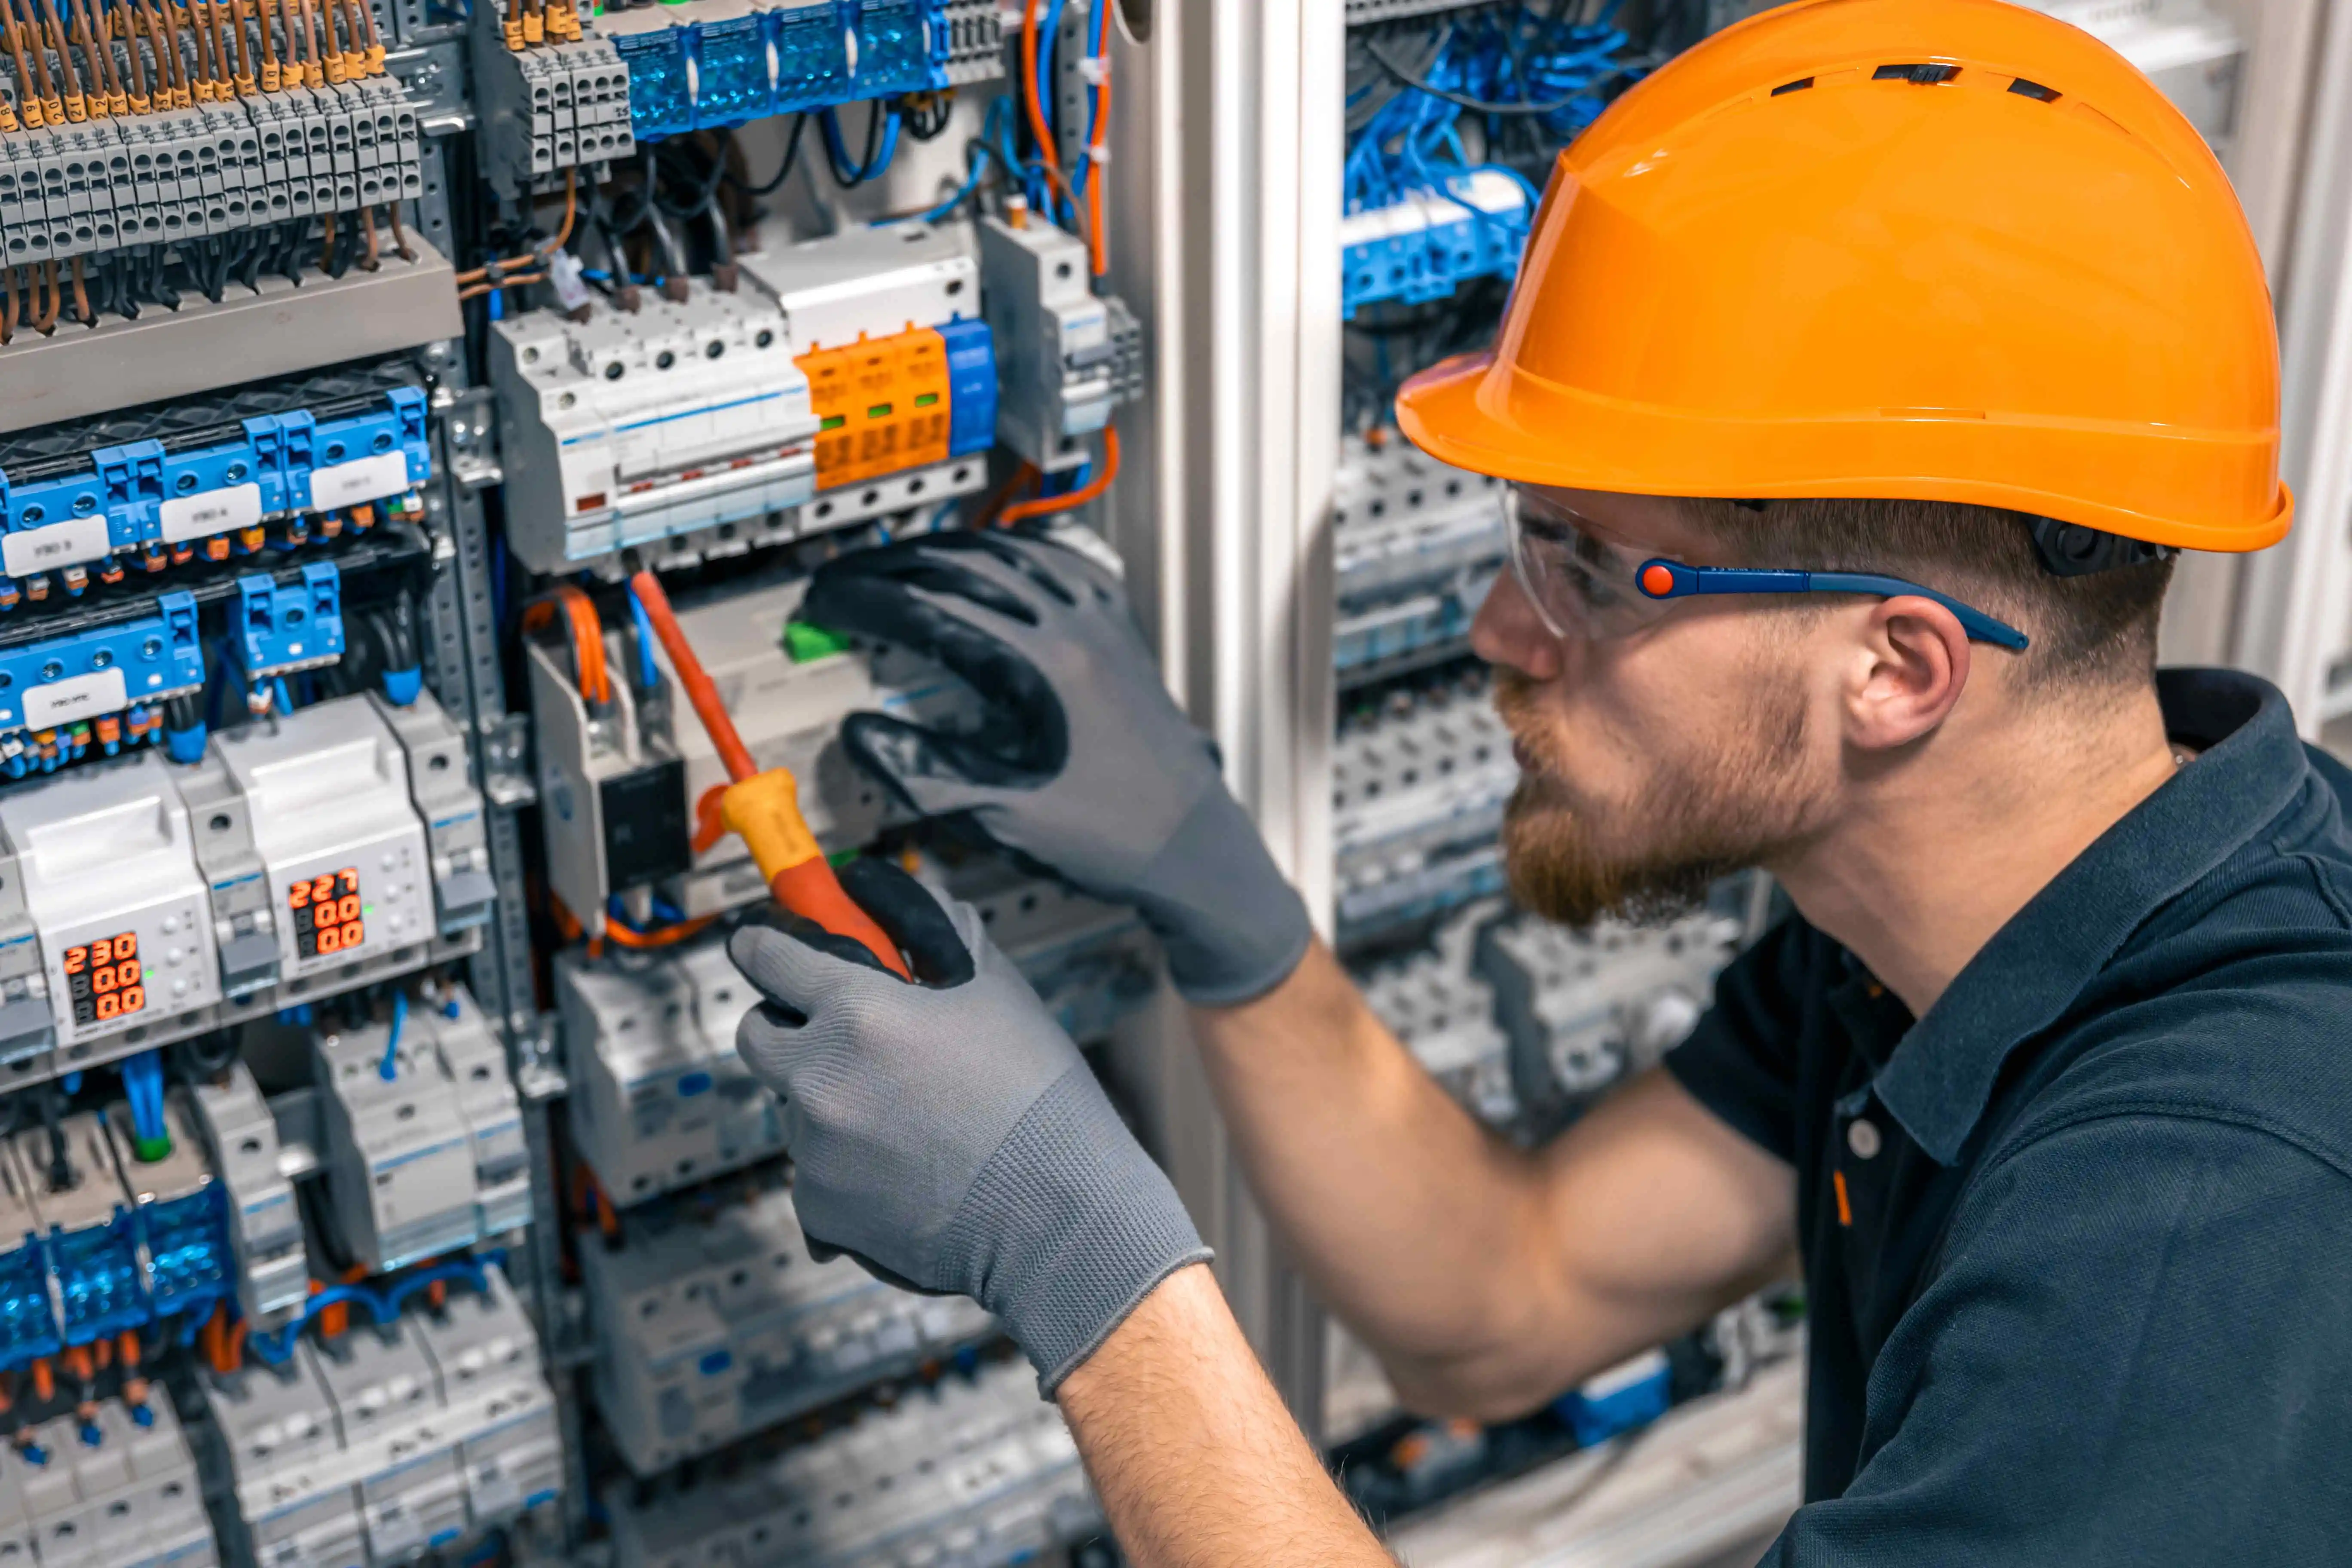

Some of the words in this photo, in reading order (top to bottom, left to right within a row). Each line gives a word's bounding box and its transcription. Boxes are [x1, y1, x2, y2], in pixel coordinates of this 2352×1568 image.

[0, 107, 14, 129] 18
[26, 104, 41, 125] 19
[49, 101, 64, 119] 20
[69, 103, 82, 117] 21
[95, 100, 109, 119] 22
[113, 100, 126, 117] 23
[289, 867, 358, 908] 227
[64, 932, 137, 974] 230
